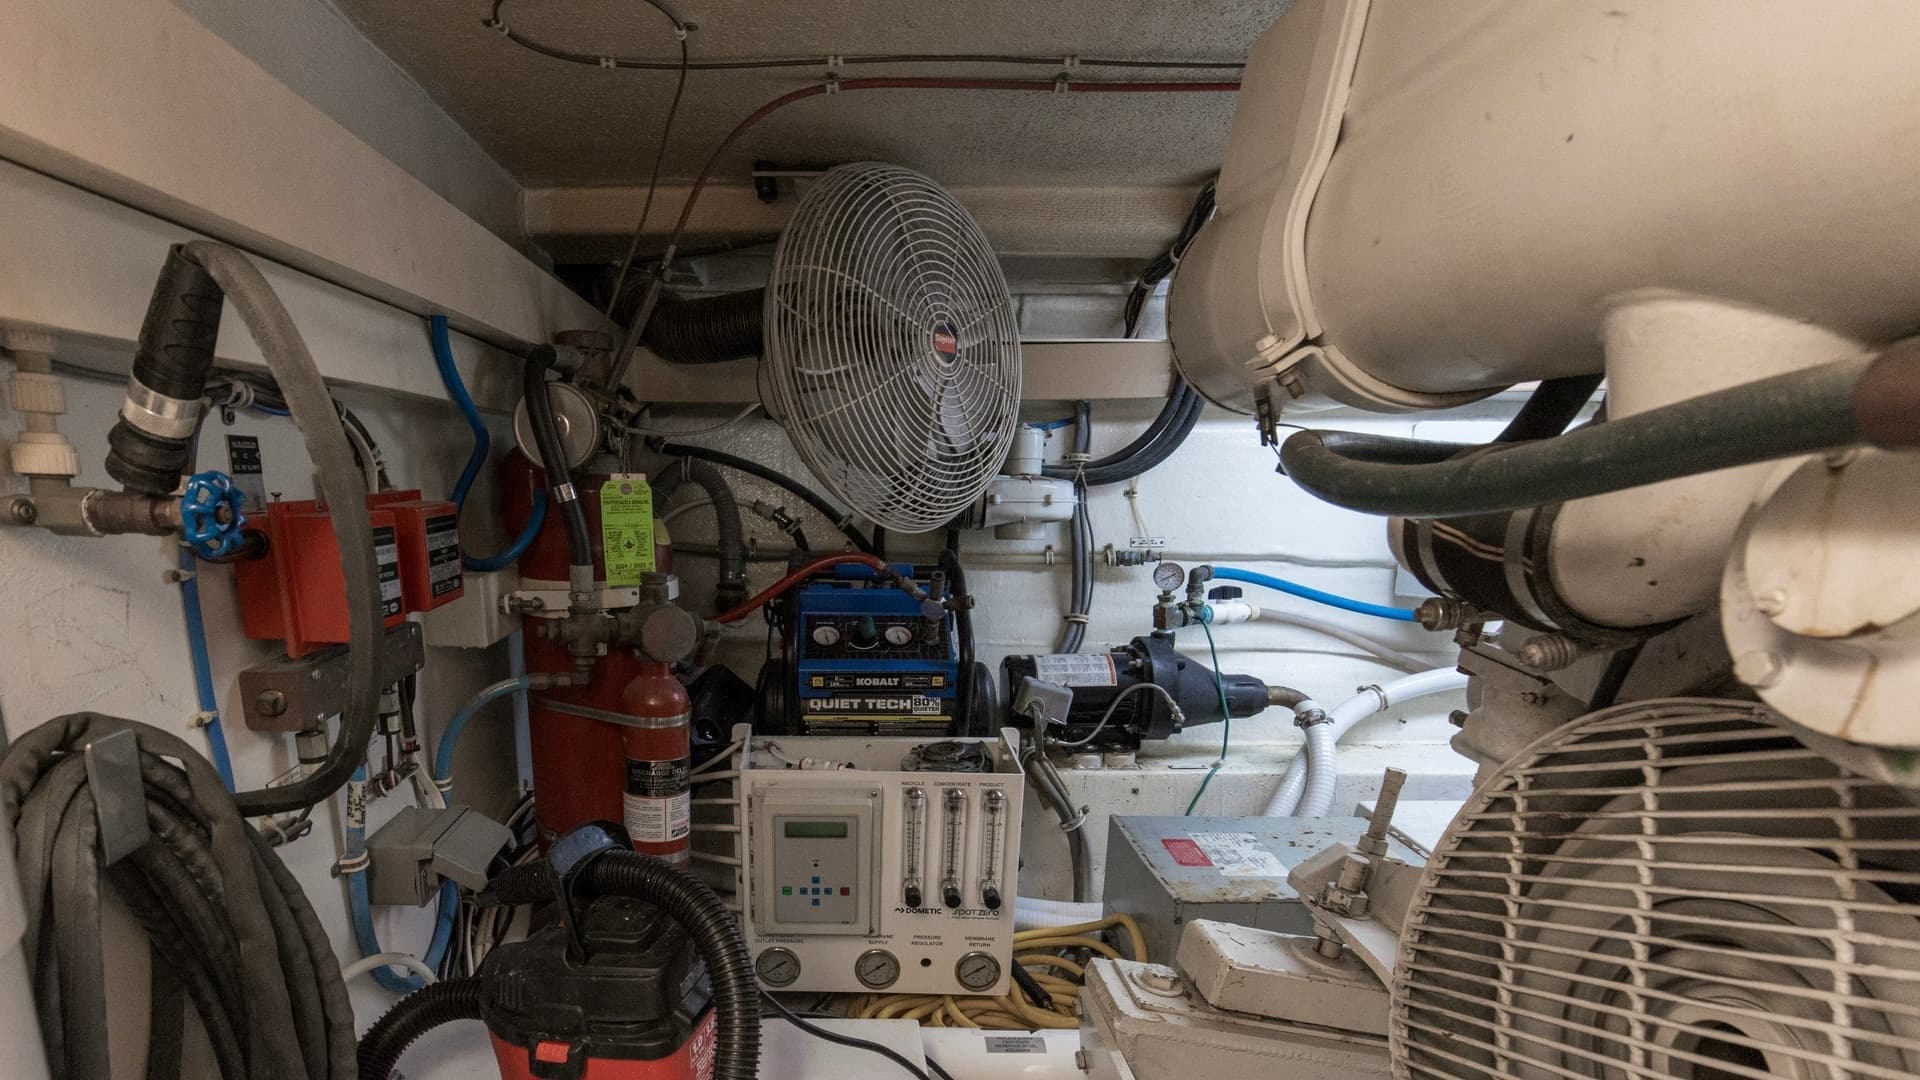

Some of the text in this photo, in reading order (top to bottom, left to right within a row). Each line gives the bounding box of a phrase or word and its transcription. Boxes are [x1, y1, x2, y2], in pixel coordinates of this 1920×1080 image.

[856, 677, 900, 686] KOBALT
[809, 698, 912, 711] QUIET TECH
[913, 697, 940, 707] 80%
[905, 907, 942, 915] DOMETIC
